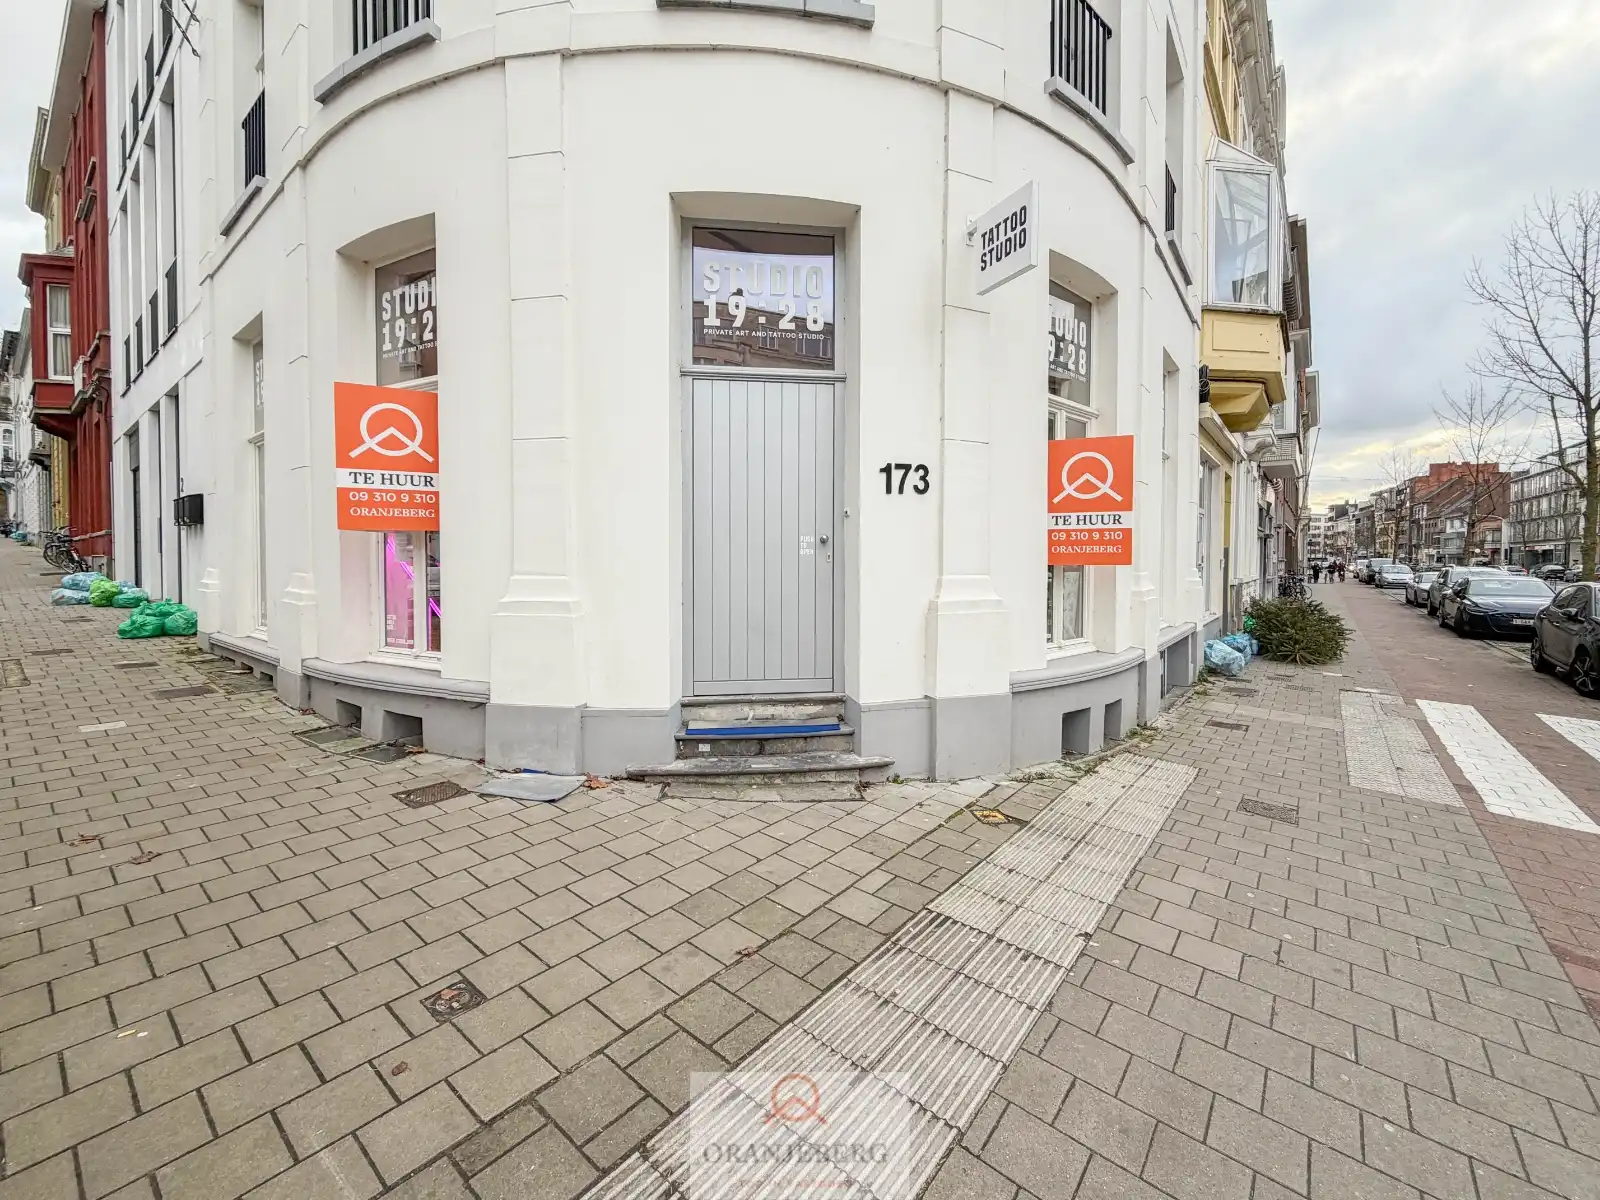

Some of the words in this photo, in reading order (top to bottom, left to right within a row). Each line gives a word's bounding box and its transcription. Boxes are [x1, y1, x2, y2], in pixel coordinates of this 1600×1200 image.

[981, 205, 1027, 250] TATTOO
[980, 227, 1027, 272] STUDIO
[703, 261, 824, 298] STUDIO
[703, 294, 825, 332] 19:28
[703, 328, 733, 336] PRIVATE
[349, 472, 375, 484] TE
[380, 473, 435, 488] HUUR
[879, 463, 930, 495] 173
[349, 491, 368, 501] 09
[373, 493, 396, 503] 310
[400, 494, 409, 503] 9
[413, 494, 436, 504] 310
[350, 507, 435, 518] ORANJEBERG
[1052, 515, 1072, 526] TE
[1076, 514, 1123, 526] HUUR
[1051, 532, 1066, 541] 09
[1070, 532, 1088, 541] 310
[1092, 532, 1100, 540] 9
[1103, 531, 1123, 540] 310
[1051, 545, 1122, 554] ORANJEBERG
